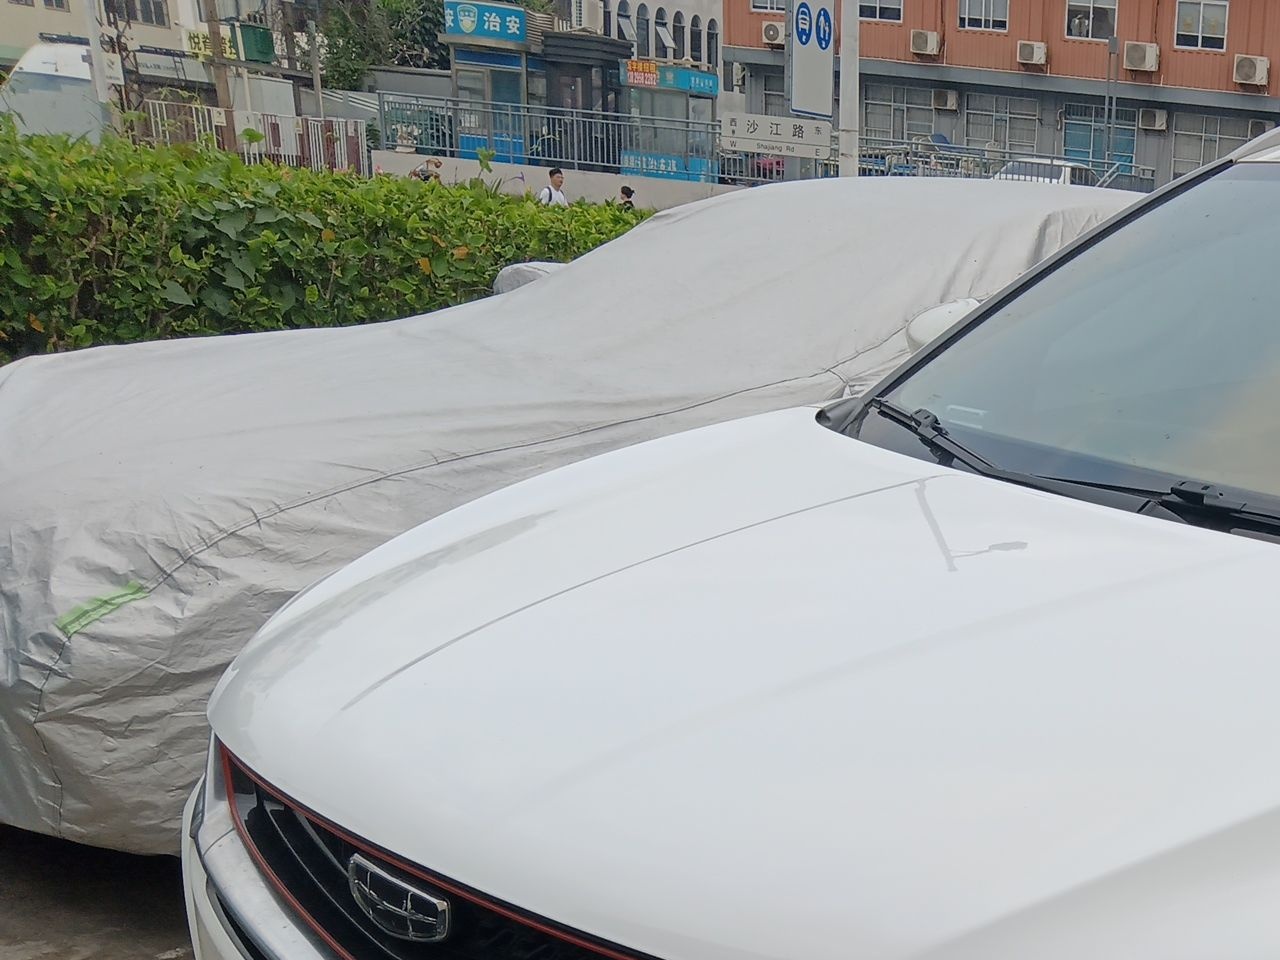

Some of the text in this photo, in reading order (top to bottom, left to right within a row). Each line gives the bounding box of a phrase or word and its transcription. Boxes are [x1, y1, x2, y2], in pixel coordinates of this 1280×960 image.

[483, 12, 520, 35] 治安
[729, 117, 737, 127] 西
[746, 119, 805, 139] 沙江路
[814, 126, 822, 135] 东
[729, 140, 737, 148] W
[756, 142, 795, 153] Shajiang Rd
[815, 148, 820, 157] E
